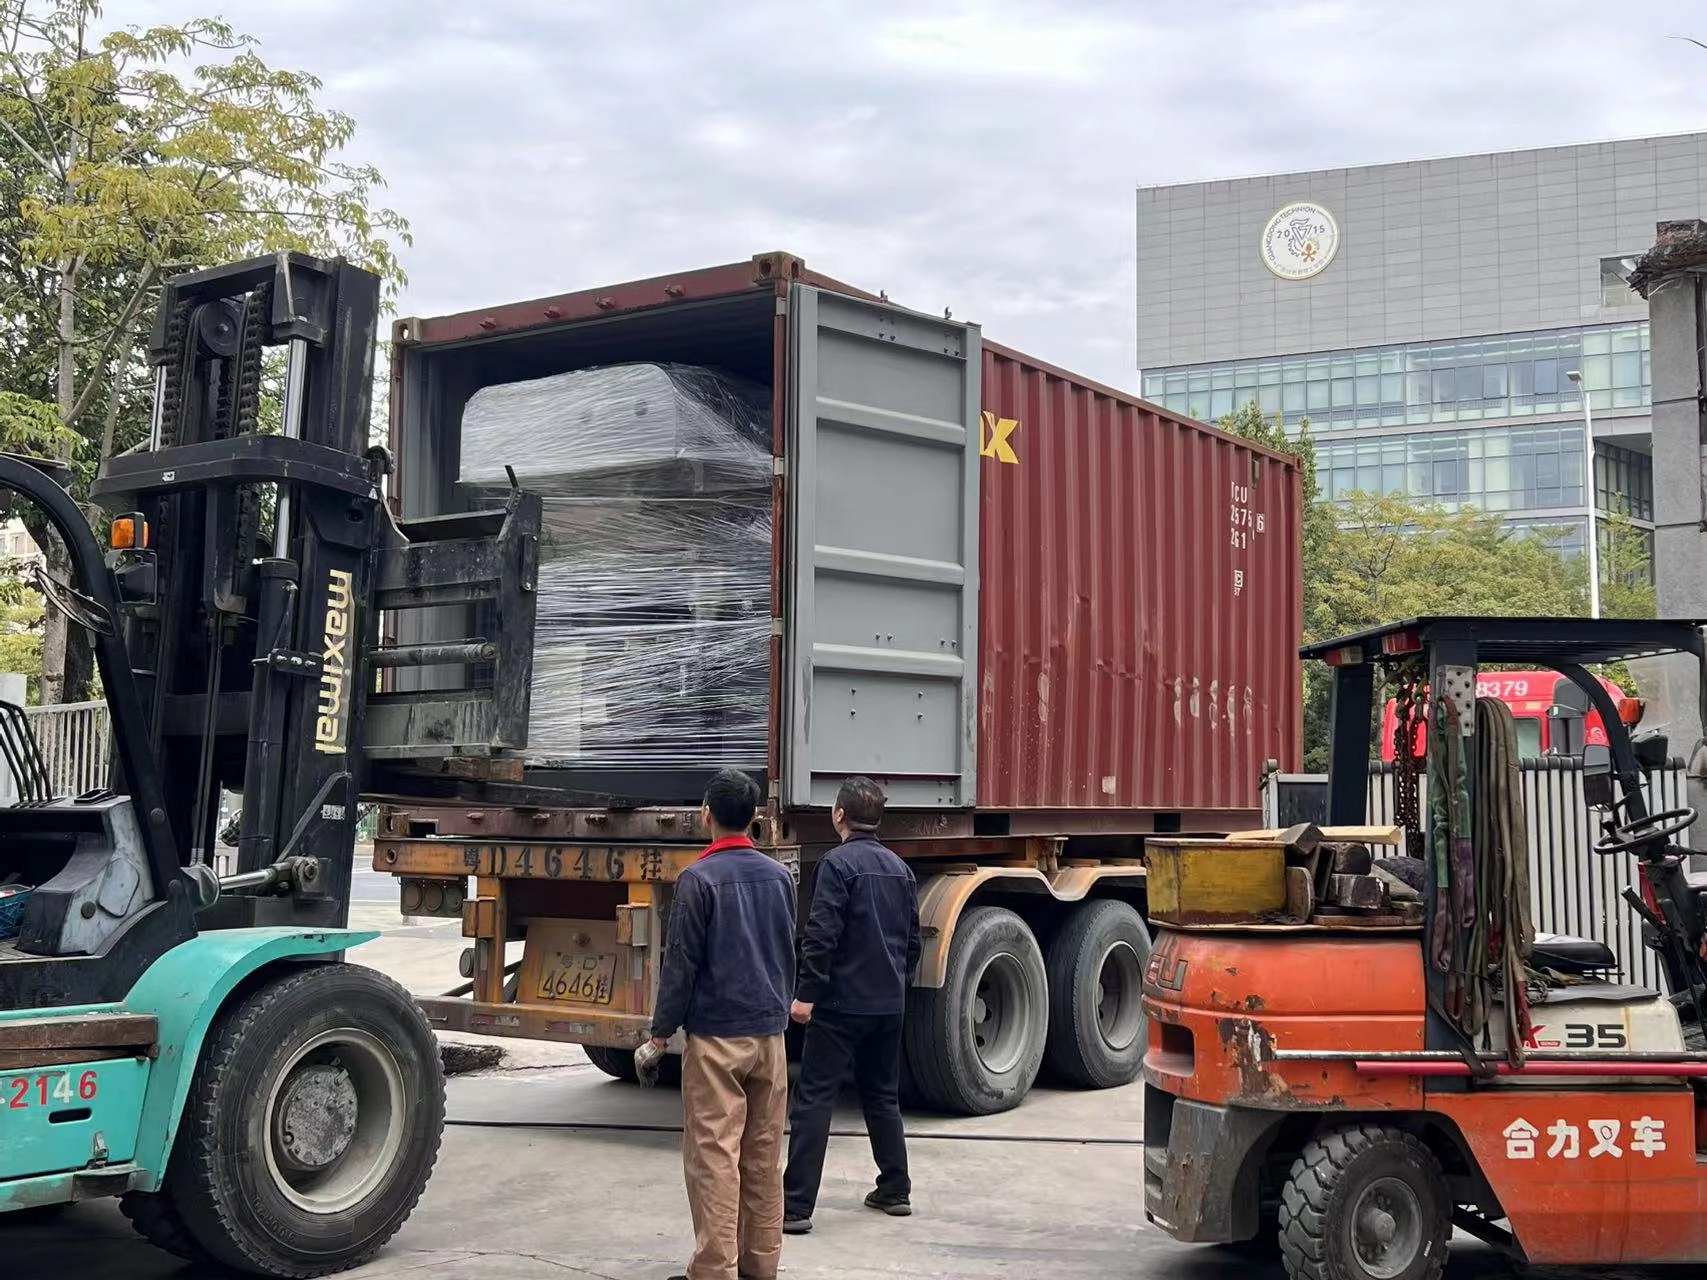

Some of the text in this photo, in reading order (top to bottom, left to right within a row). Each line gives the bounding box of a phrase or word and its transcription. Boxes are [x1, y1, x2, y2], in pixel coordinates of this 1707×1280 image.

[980, 409, 1020, 464] X
[315, 569, 353, 753] maximal
[1476, 680, 1529, 697] 8379
[1565, 1024, 1626, 1048] 35
[0, 1071, 97, 1108] 2146
[1502, 1116, 1666, 1159] 合力叉车
